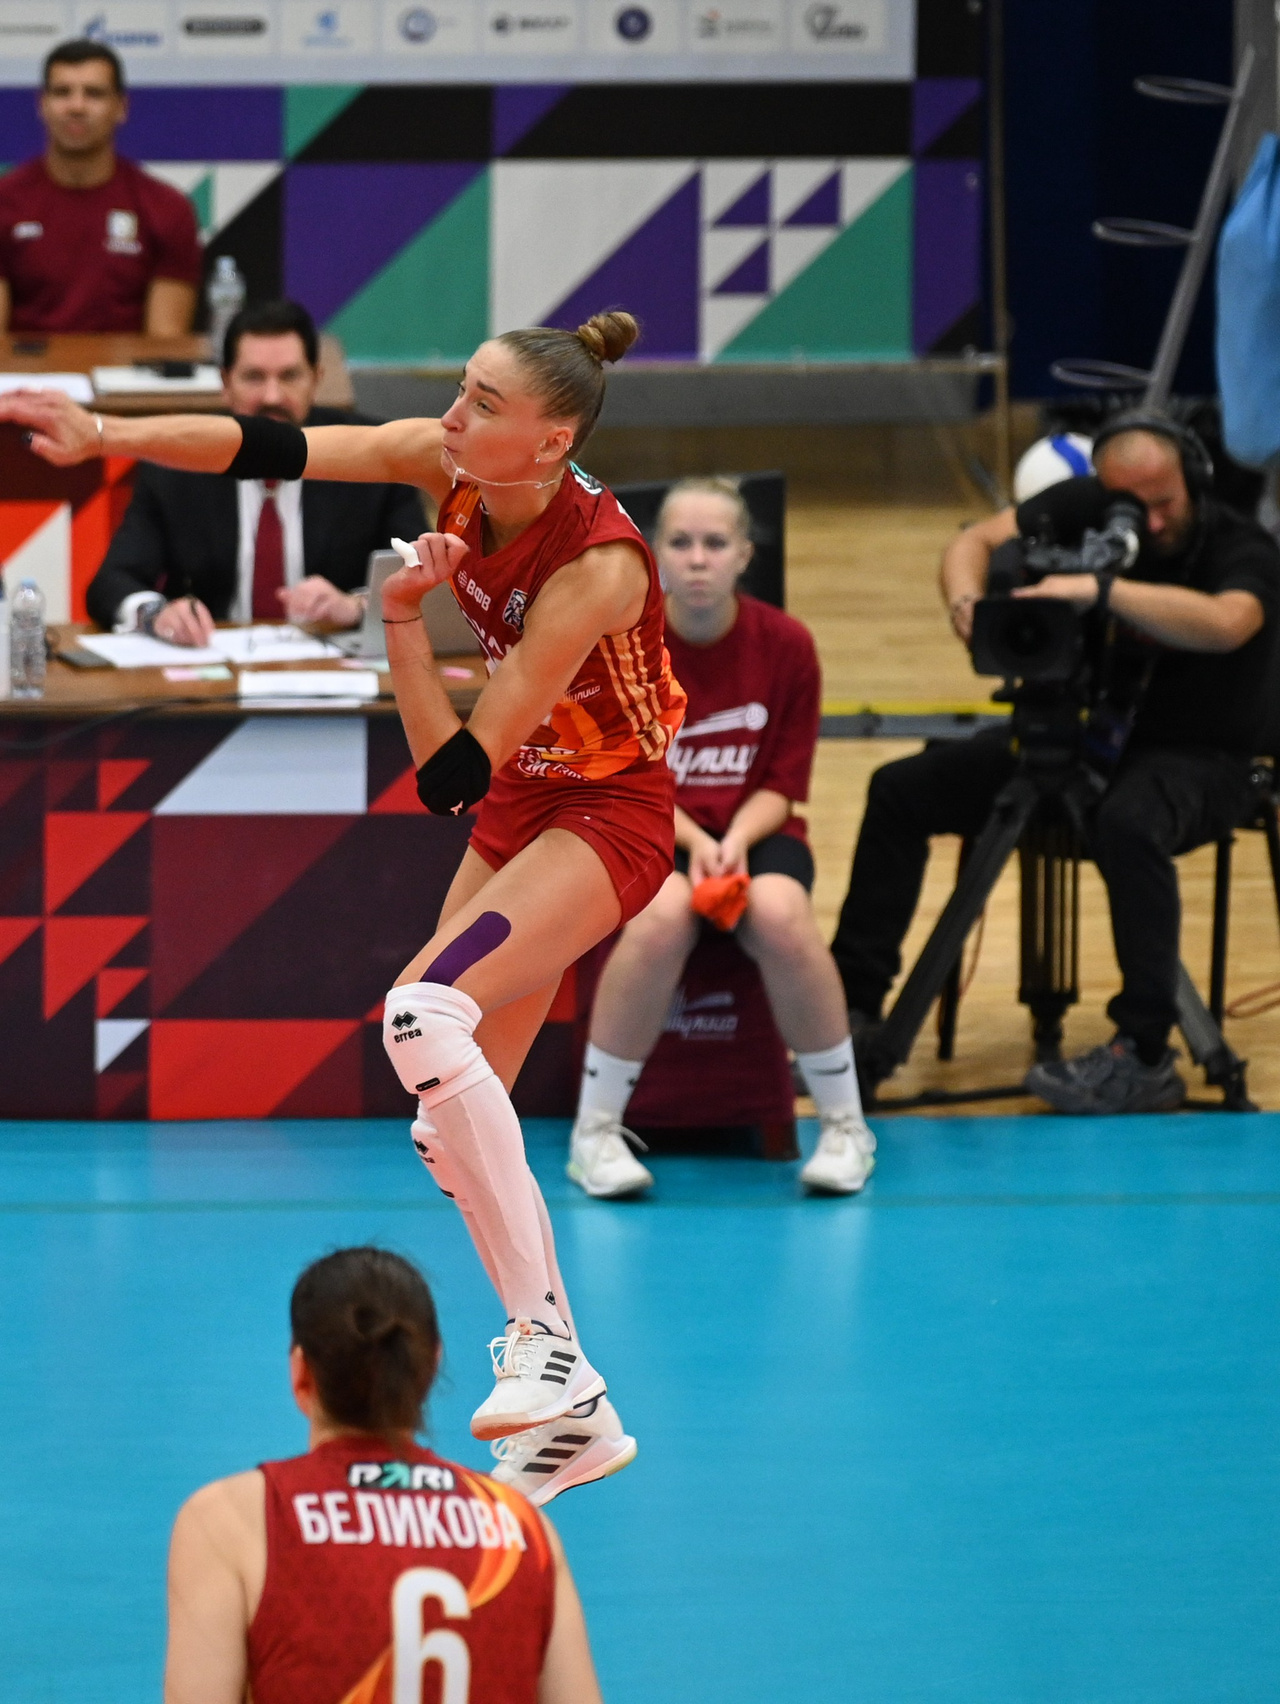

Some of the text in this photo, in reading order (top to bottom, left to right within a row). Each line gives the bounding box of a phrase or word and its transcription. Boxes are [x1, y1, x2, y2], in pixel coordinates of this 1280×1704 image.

[466, 578, 491, 611] ВФВ
[394, 1027, 422, 1044] errea
[293, 1490, 528, 1553] БЕЛИКОВА
[391, 1566, 472, 1704] 6
